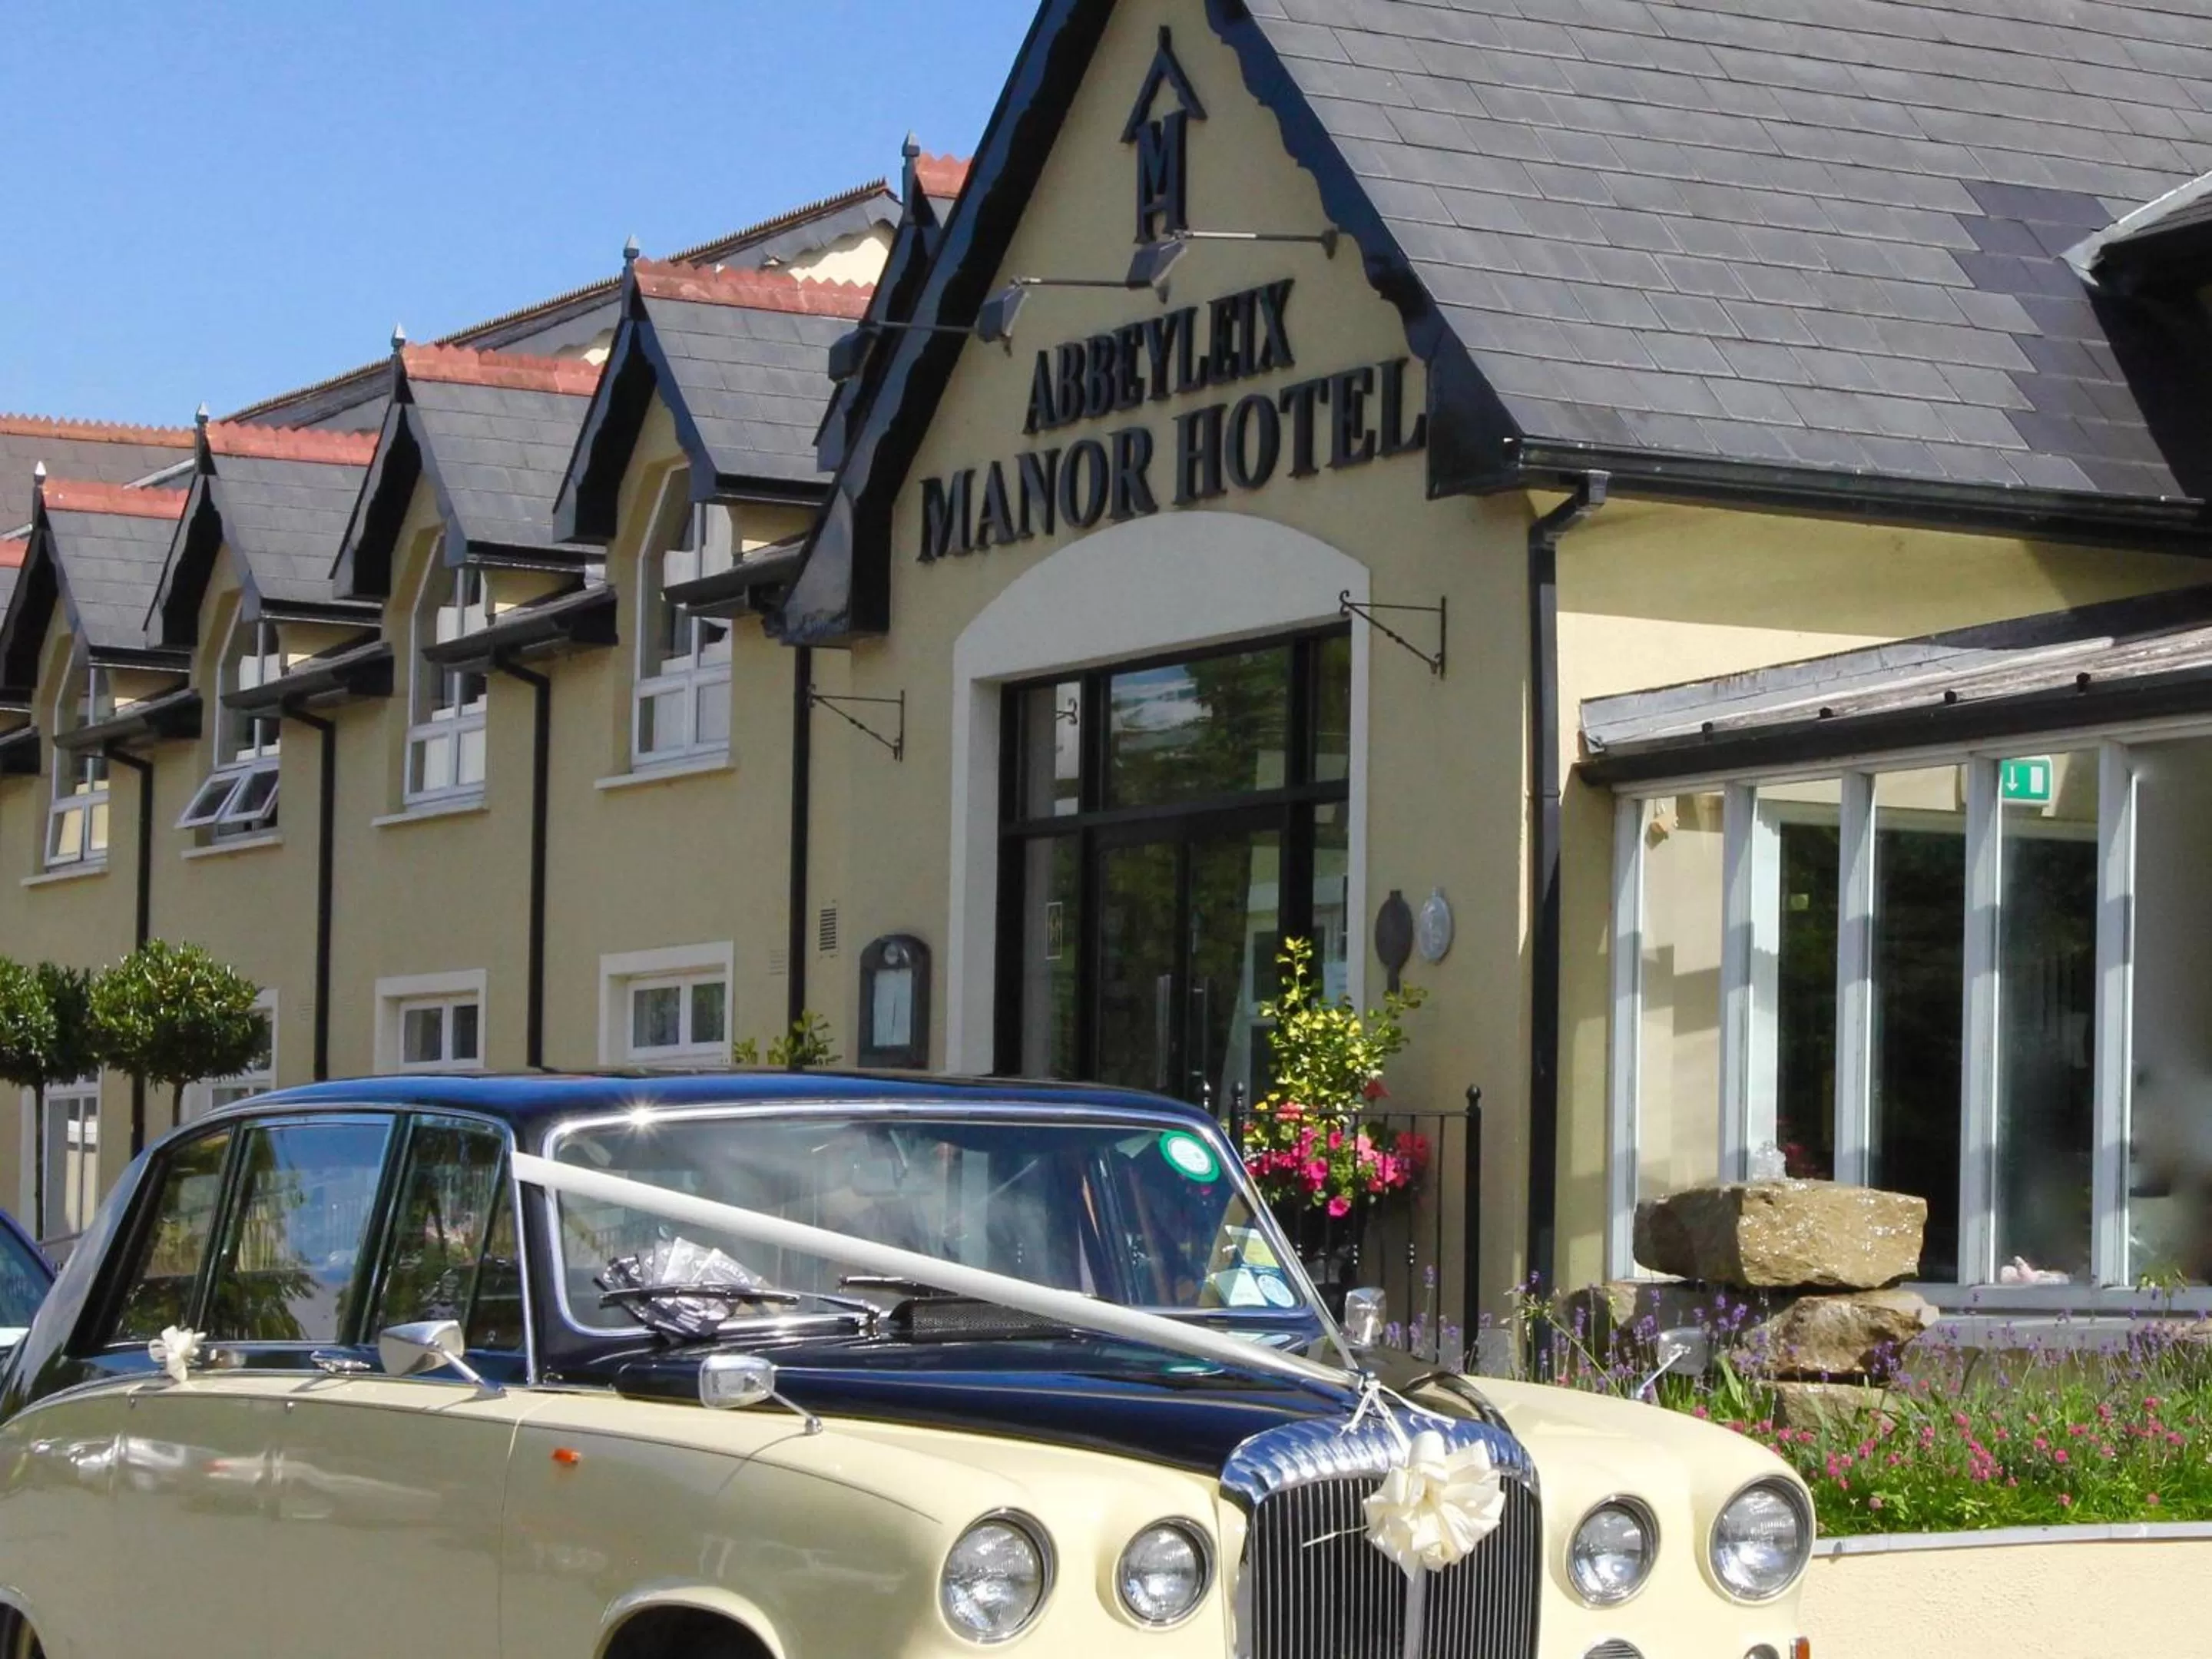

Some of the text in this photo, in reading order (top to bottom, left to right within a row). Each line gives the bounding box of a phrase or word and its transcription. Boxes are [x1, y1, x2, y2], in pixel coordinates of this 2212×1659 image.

[1022, 278, 1296, 435] ABBEYLEIX
[916, 358, 1427, 564] MANOR HOTEL
